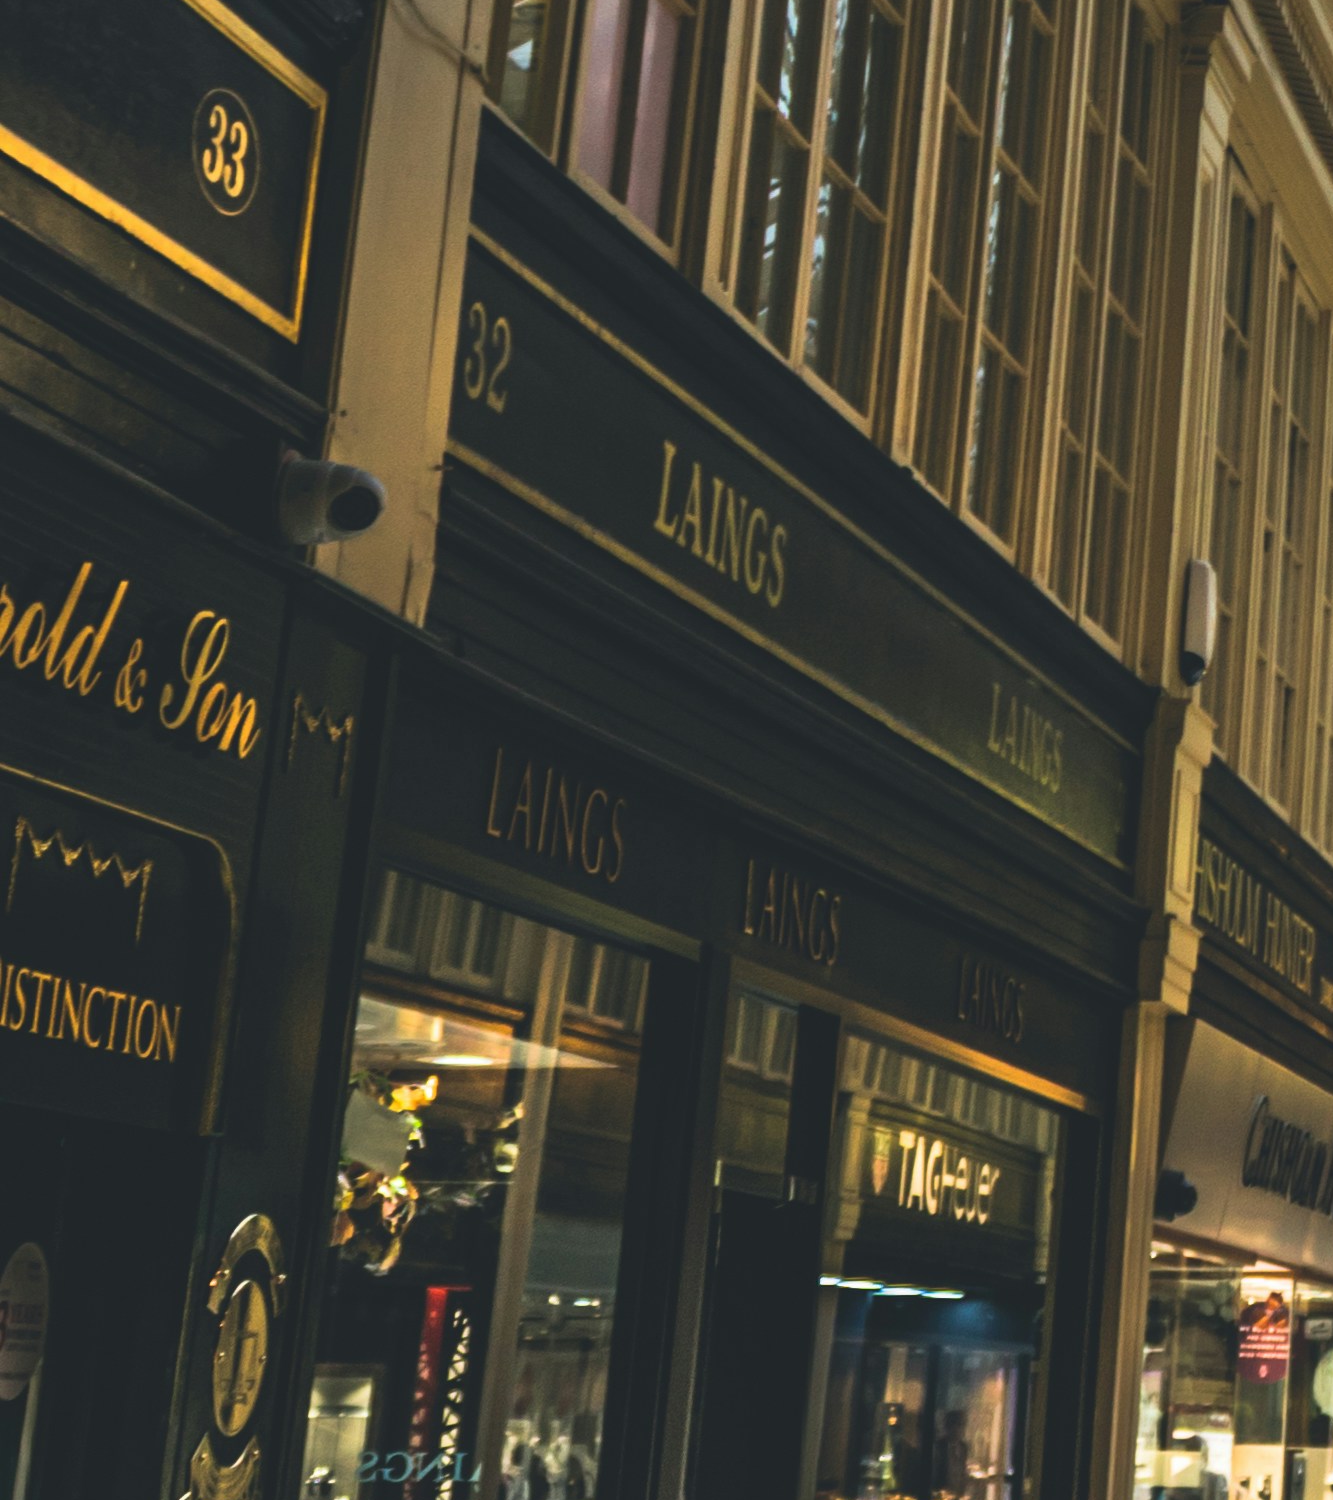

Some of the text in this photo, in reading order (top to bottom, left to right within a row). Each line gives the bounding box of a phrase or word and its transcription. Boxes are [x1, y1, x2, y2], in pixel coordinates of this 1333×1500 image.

[202, 105, 249, 198] 33
[463, 301, 512, 414] 32
[653, 439, 789, 609] LAINGS
[114, 637, 148, 714] &
[159, 609, 262, 760] Son
[986, 682, 1064, 794] LAINGS
[485, 746, 1027, 1045] LAINGS LAINGS LAINGS
[1197, 838, 1317, 998] HISHOLM HUNTER
[0, 956, 182, 1065] ISTINCTION
